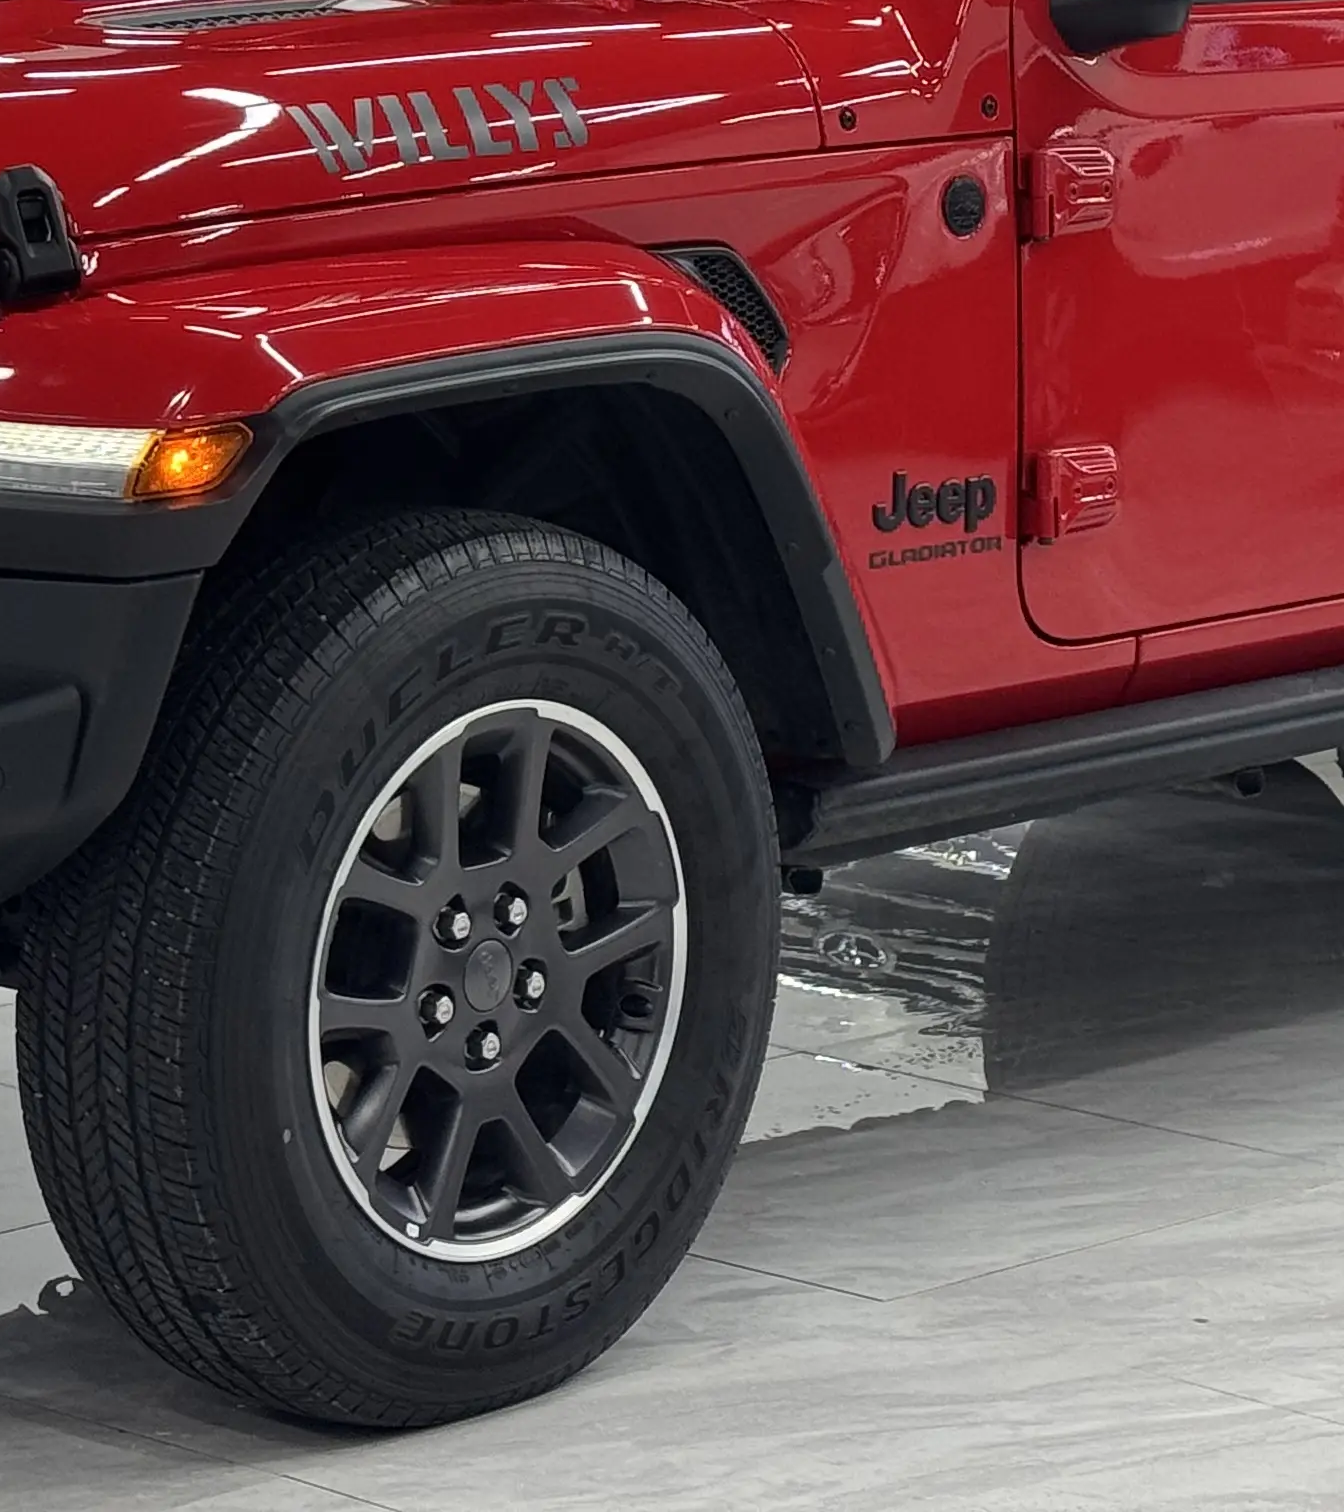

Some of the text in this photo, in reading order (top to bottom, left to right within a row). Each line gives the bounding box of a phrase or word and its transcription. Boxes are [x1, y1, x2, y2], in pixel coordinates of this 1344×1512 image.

[285, 76, 588, 174] WILLYS
[871, 468, 997, 534] Jeep
[868, 534, 1002, 570] GLADIATOR
